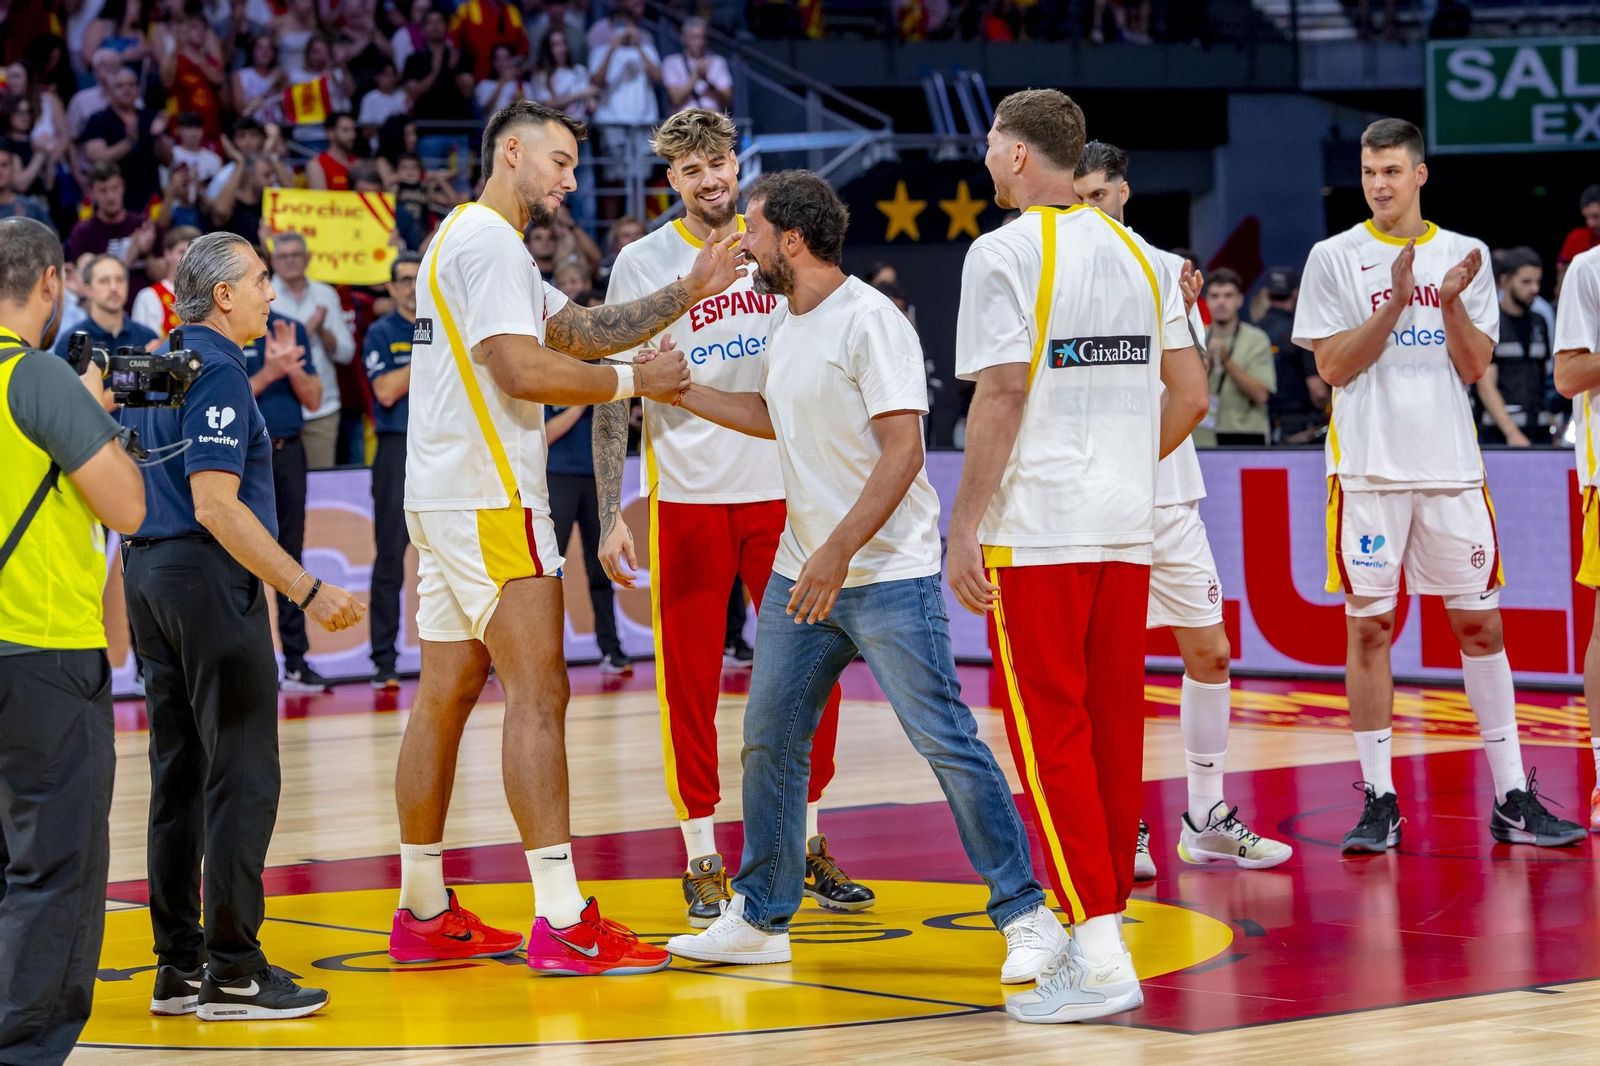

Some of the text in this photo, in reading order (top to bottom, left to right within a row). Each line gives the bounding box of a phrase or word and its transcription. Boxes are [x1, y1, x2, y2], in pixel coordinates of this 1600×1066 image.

[1446, 48, 1600, 101] SAL
[1532, 103, 1600, 143] EX
[129, 360, 150, 368] CRANE
